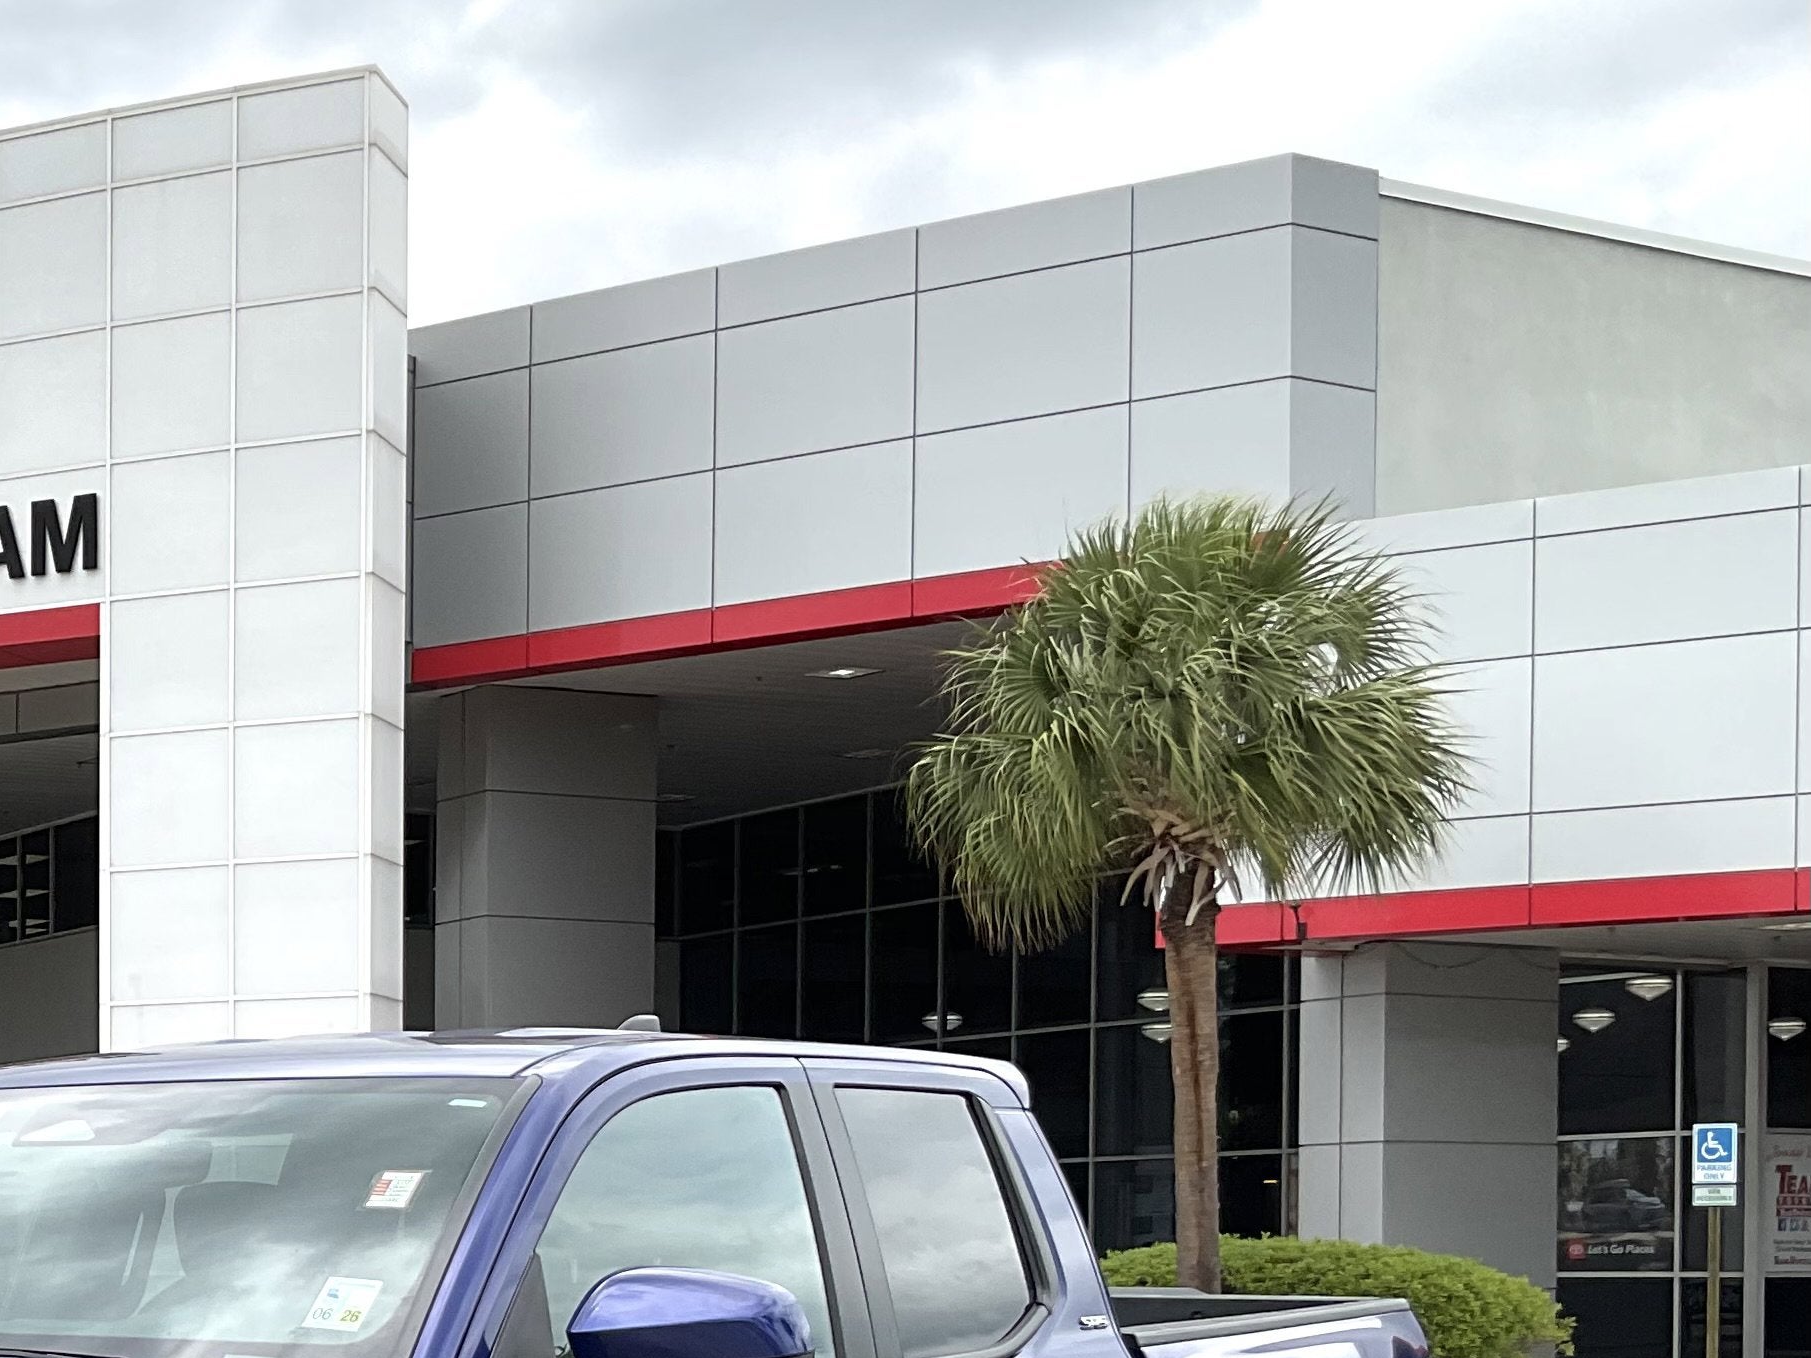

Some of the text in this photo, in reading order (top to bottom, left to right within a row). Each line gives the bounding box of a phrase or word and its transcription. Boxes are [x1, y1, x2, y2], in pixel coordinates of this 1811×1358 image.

[1775, 1165, 1811, 1195] TEA
[312, 1307, 362, 1323] 06 26
